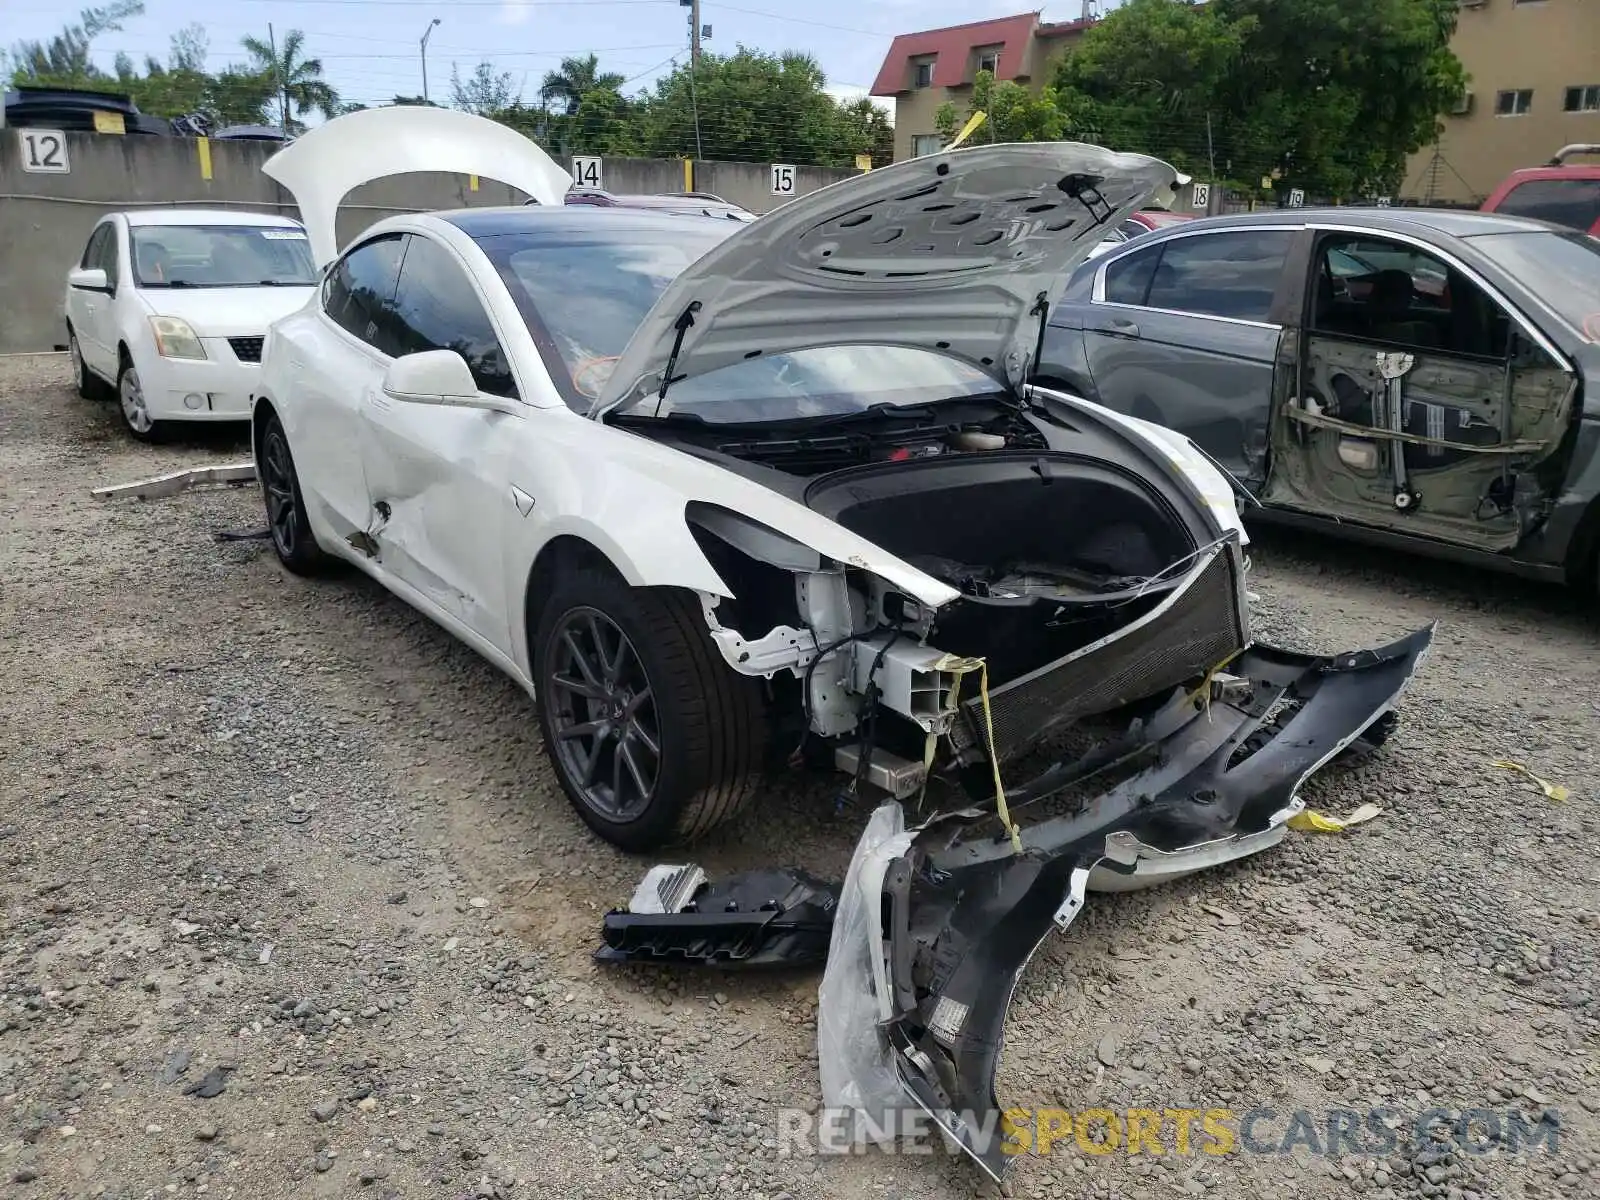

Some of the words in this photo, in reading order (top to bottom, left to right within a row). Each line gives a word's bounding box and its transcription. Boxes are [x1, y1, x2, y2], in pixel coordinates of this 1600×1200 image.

[25, 135, 64, 167] 12
[575, 160, 599, 187] 14
[774, 168, 793, 192] 15
[1194, 187, 1208, 206] 18
